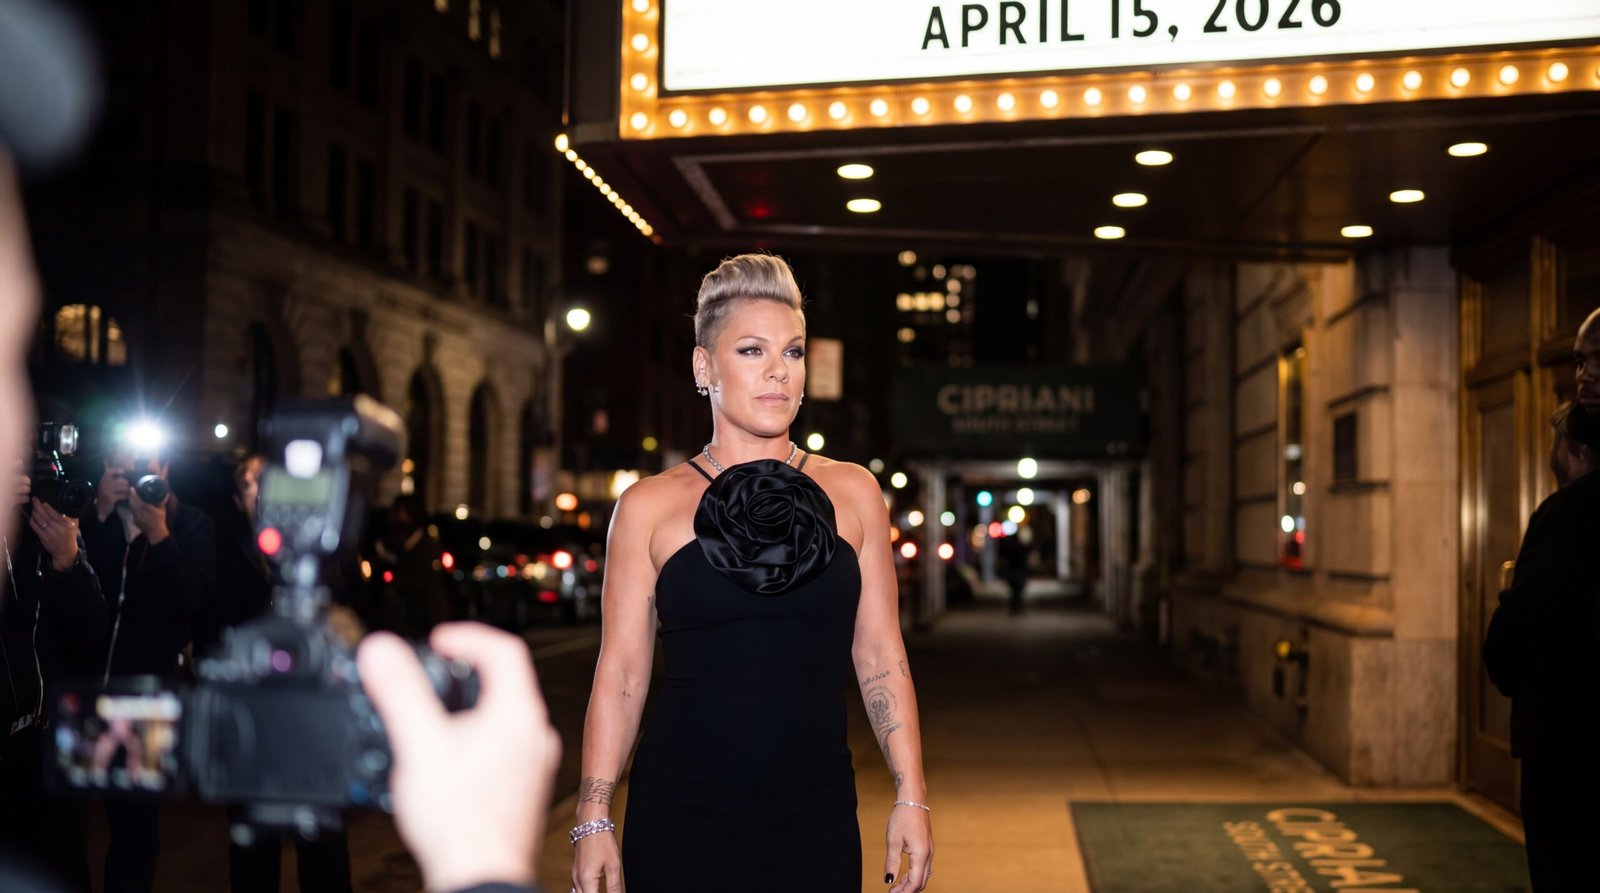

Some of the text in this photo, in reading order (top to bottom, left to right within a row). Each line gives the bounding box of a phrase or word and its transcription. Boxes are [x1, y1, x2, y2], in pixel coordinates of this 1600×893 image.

[921, 0, 1342, 49] APRIL 15, 2026
[937, 384, 1095, 414] CIPRIANI
[1267, 807, 1420, 893] CIPRIA
